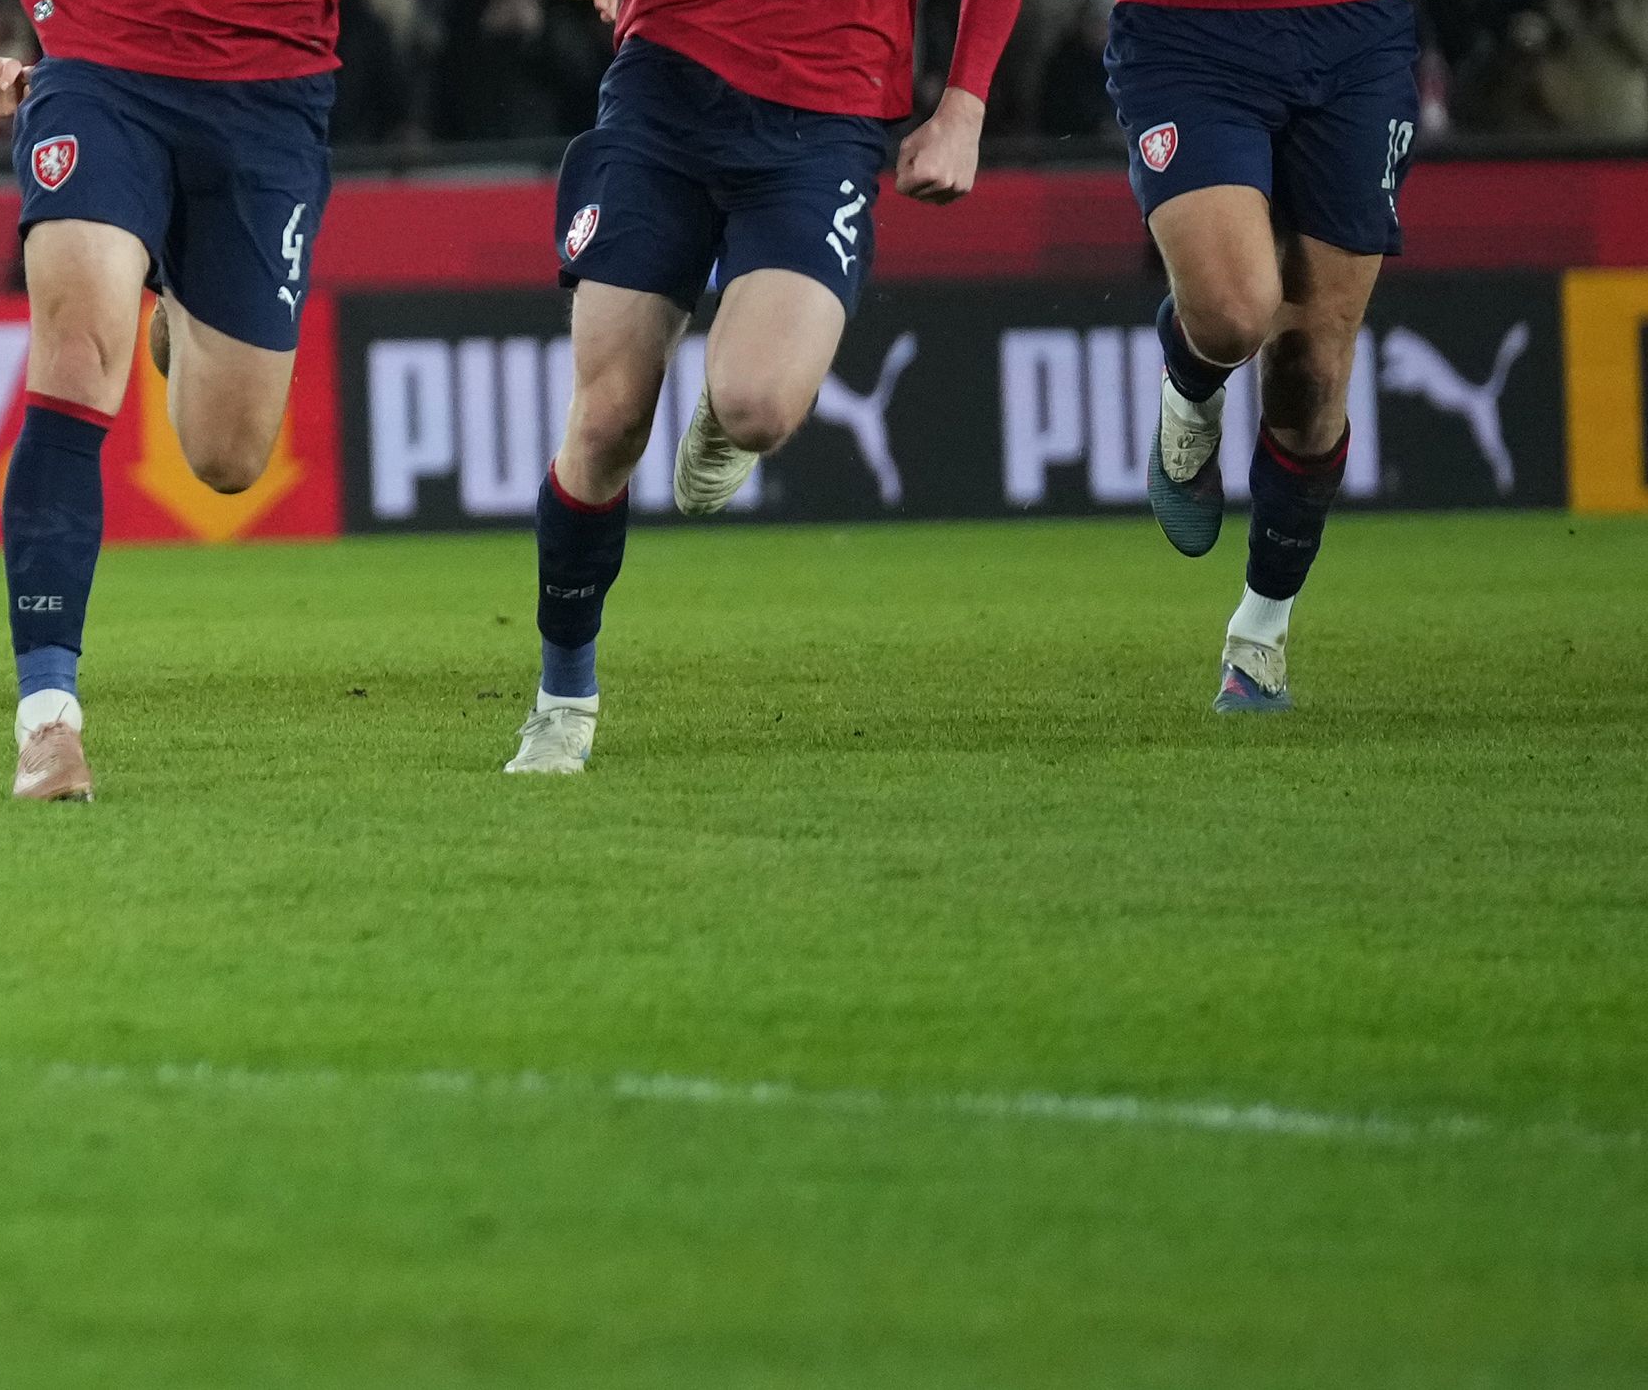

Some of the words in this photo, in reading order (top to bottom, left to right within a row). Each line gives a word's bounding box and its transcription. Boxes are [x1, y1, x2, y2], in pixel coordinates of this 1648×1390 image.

[1381, 118, 1413, 190] 19
[281, 203, 307, 281] 4
[832, 179, 866, 244] 2
[18, 595, 63, 612] CZE
[546, 583, 596, 599] CZE
